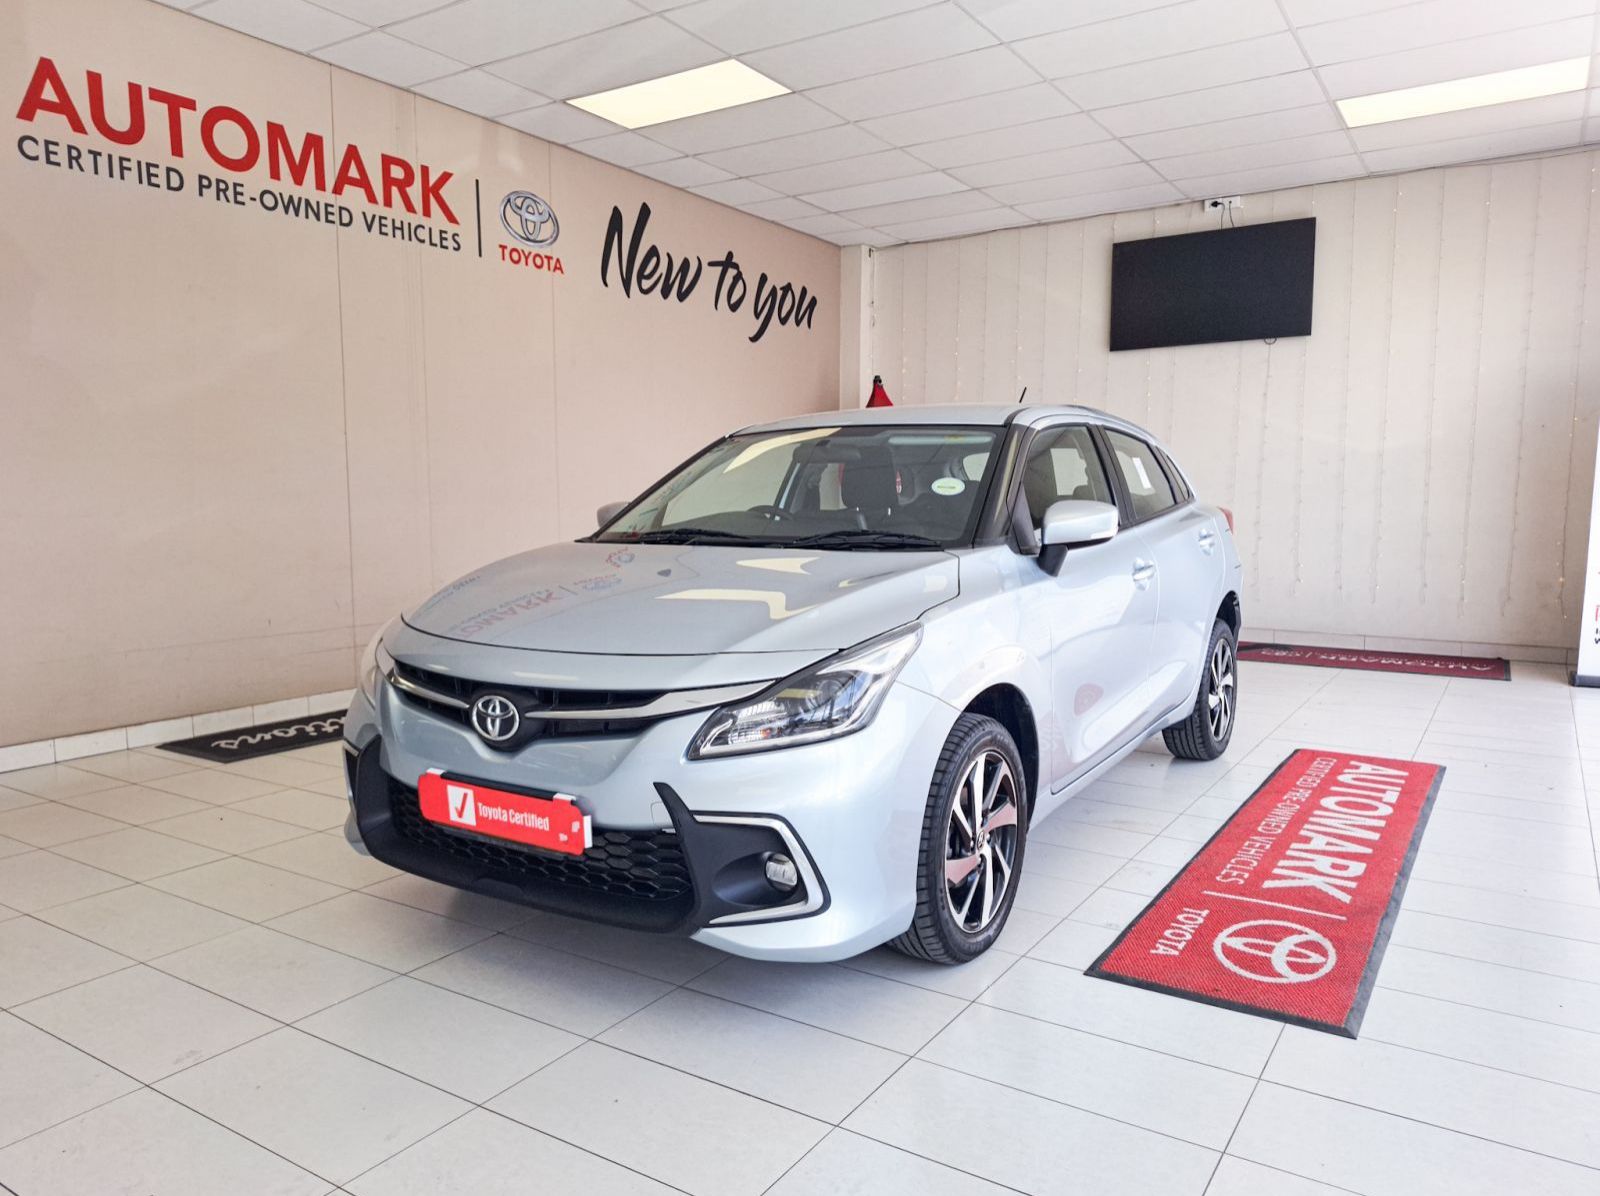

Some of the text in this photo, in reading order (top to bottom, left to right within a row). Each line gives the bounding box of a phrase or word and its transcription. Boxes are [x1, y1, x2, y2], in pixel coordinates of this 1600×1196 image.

[16, 56, 460, 226] AUTOMARK
[17, 135, 462, 252] CERTIFIED PRE-OWNED VEHICLES
[499, 244, 564, 275] TOYOTA
[600, 202, 818, 343] New to you
[476, 802, 508, 823] Toyota
[508, 808, 550, 832] Certified
[1215, 757, 1337, 886] CERTIFIED PRE-OWNED VEHICLES
[1261, 760, 1410, 905] AUTOMARK
[1149, 908, 1211, 958] TOYOTA
